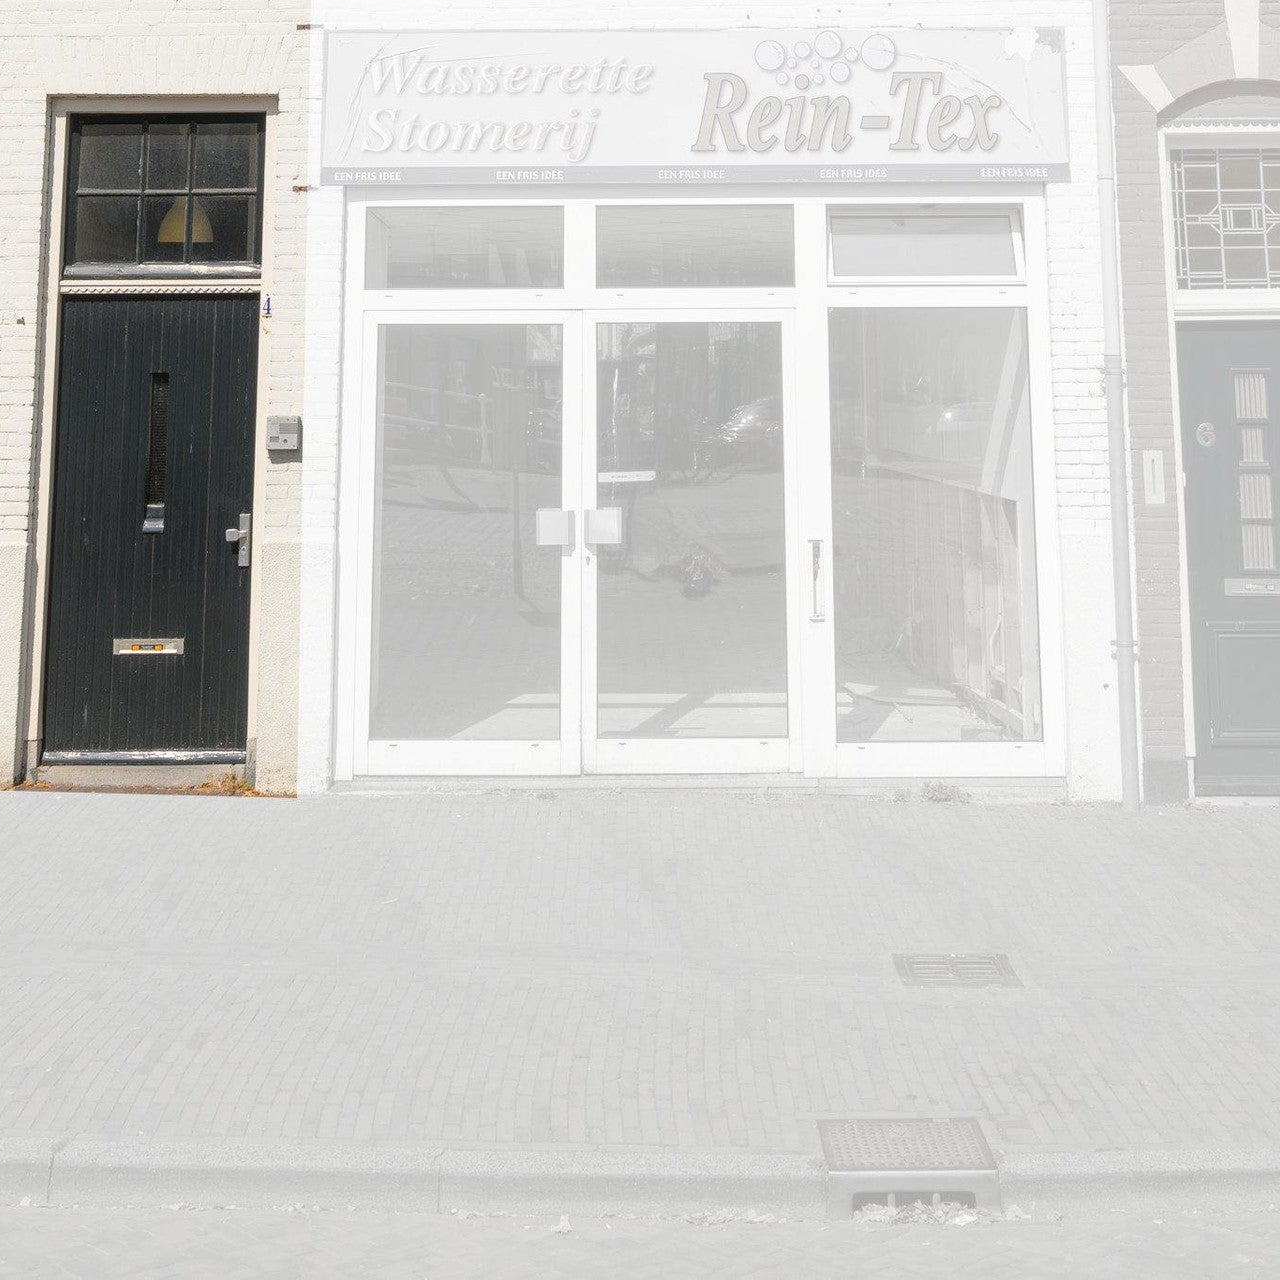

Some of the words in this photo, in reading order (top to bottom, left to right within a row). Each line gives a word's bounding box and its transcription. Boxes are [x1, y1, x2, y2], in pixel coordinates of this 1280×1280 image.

[369, 54, 656, 95] Wasserette
[691, 71, 1004, 153] Rein-Tex
[360, 107, 601, 162] Stomerij
[335, 172, 353, 181] EEN
[355, 172, 376, 181] FRIS
[378, 172, 402, 181] IDEE
[496, 171, 515, 180] EEN
[517, 171, 538, 180] FRIS
[541, 171, 564, 180] IDEE
[658, 170, 677, 180] EEN
[679, 170, 701, 180] FRIS
[703, 170, 726, 180] IDEE
[263, 297, 271, 315] 4
